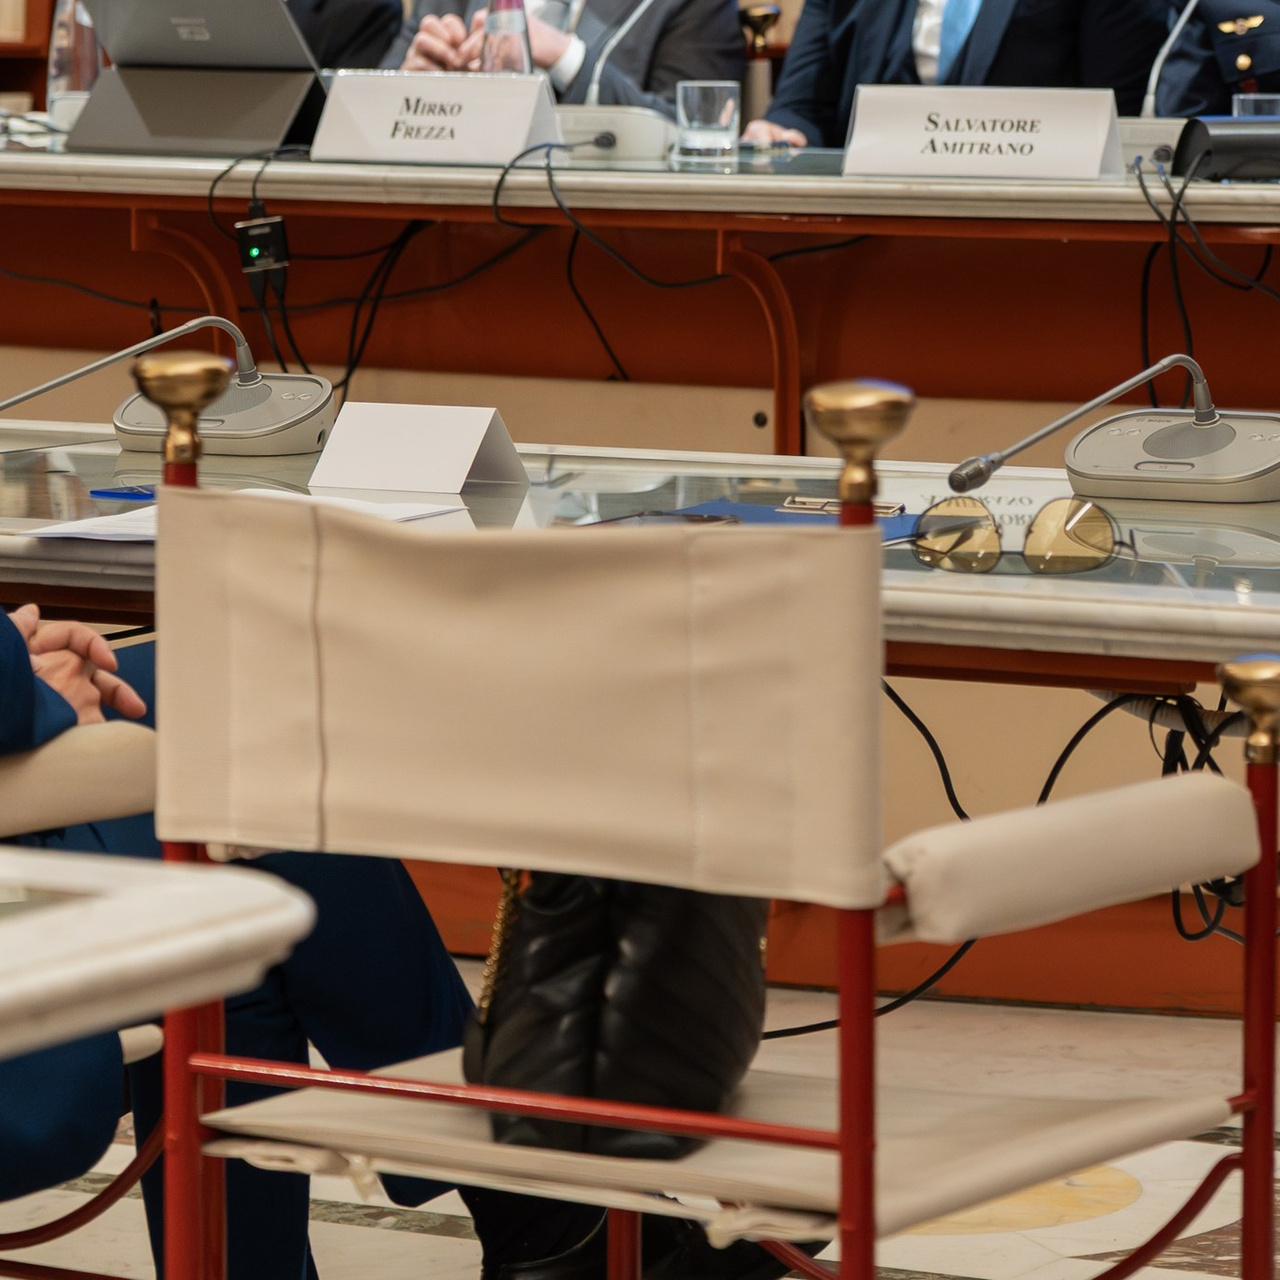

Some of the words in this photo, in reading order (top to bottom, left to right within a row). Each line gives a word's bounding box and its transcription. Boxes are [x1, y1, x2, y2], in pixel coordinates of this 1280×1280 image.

[399, 96, 462, 117] MIRKO
[391, 120, 456, 140] FREZZA
[924, 112, 1041, 133] SALVATORE
[920, 138, 1034, 156] AMITRANO
